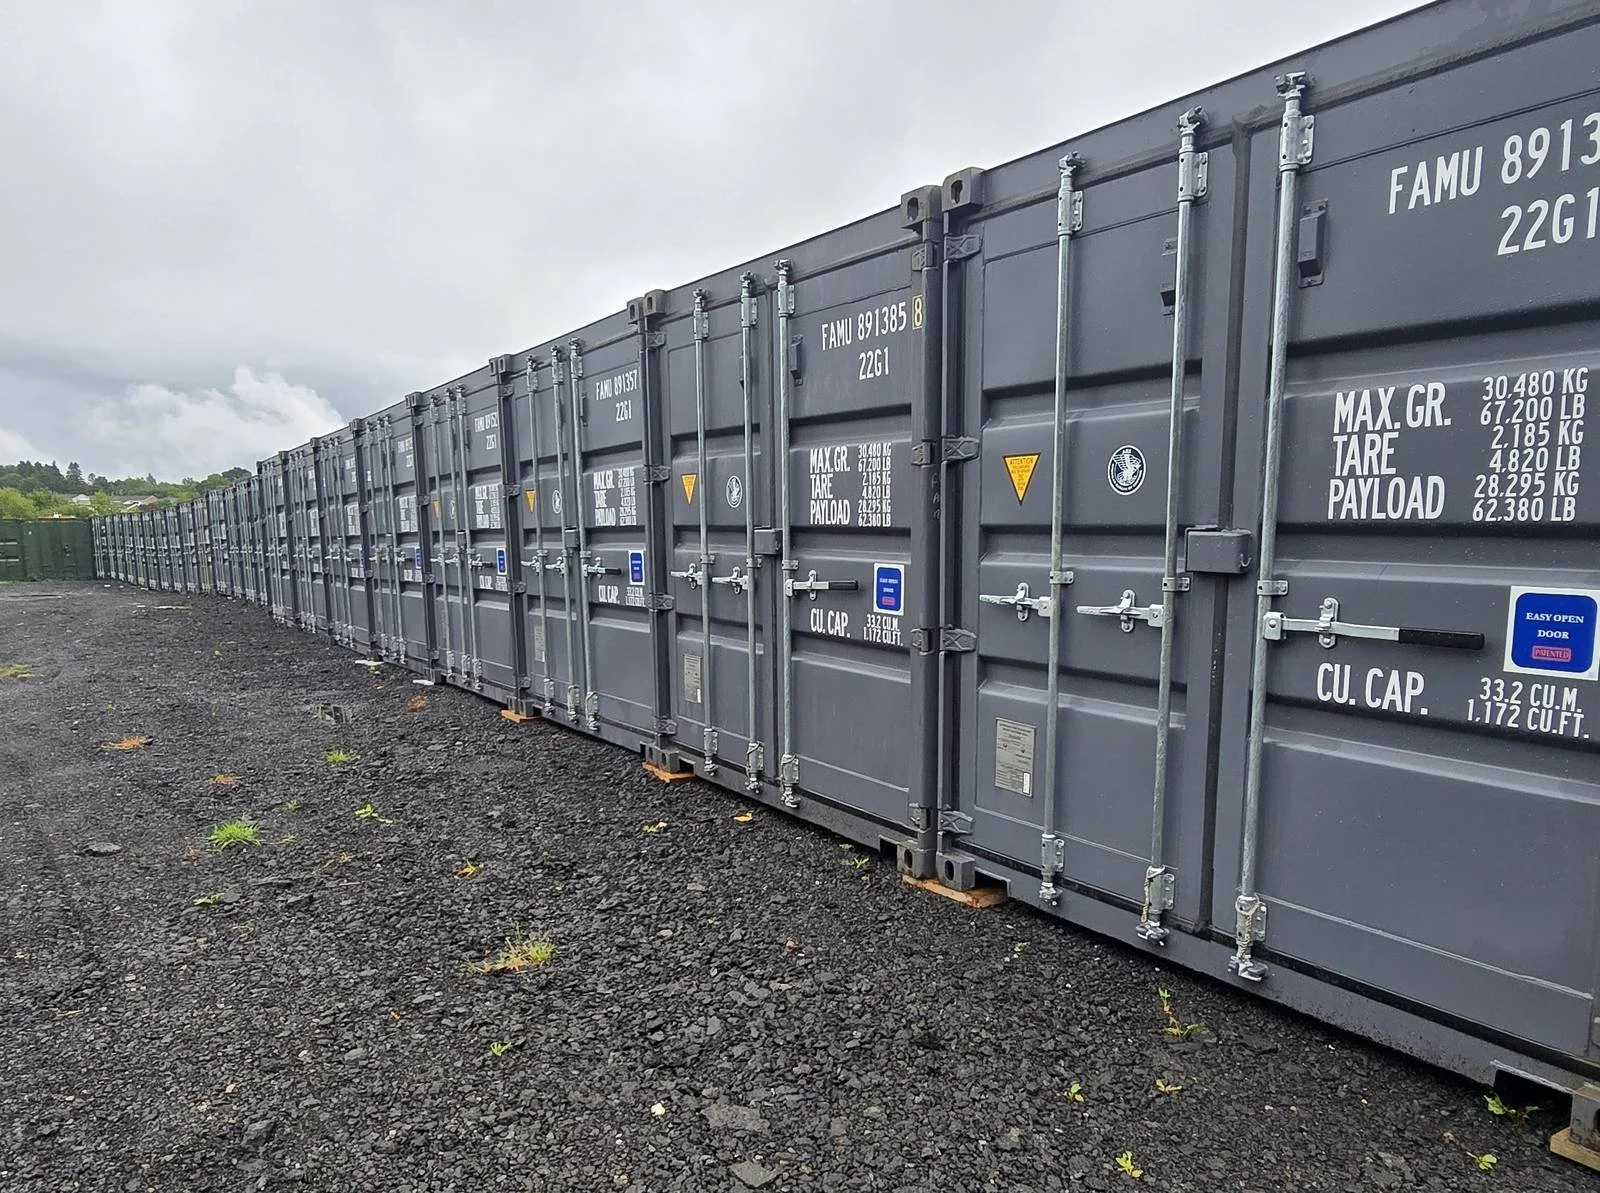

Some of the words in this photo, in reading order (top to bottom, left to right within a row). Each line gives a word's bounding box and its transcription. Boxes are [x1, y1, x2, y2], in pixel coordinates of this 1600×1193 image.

[1388, 146, 1483, 215] FAMU
[1501, 112, 1600, 184] 8913
[1497, 186, 1600, 256] 22G1
[822, 317, 852, 351] FAMU
[857, 301, 907, 341] 891385
[914, 297, 923, 327] 8
[859, 346, 889, 380] 22G1
[1482, 370, 1555, 401] 30,480
[1562, 367, 1589, 394] KG
[1333, 386, 1401, 434] MAX.
[1406, 382, 1452, 428] GR.
[1480, 396, 1553, 426] 67,200
[1560, 393, 1586, 420] LB
[1491, 422, 1550, 450] 2,185
[1557, 420, 1585, 445] KG
[810, 447, 834, 474] MAX.
[834, 445, 851, 472] GR.
[882, 442, 892, 457] KG
[882, 456, 891, 471] LB
[1333, 431, 1399, 477] TARE
[1489, 447, 1549, 473] 4,820
[1555, 446, 1581, 471] LB
[810, 473, 834, 499] TARE
[882, 471, 891, 485] KG
[882, 485, 891, 499] LB
[1474, 472, 1546, 498] 28,295
[1553, 471, 1580, 497] KG
[882, 499, 892, 513] KG
[1327, 475, 1445, 520] PAYLOAD
[1472, 497, 1544, 522] 62,380
[1550, 497, 1576, 522] LB
[810, 499, 851, 525] PAYLOAD
[882, 513, 891, 527] LB
[810, 608, 826, 634] CU.
[827, 610, 851, 638] CAP.
[1525, 612, 1553, 622] EASY
[1553, 614, 1585, 624] OPEN
[1537, 629, 1570, 640] DOOR
[1534, 647, 1570, 659] PATENTED
[1316, 662, 1356, 705] CU.
[1365, 667, 1429, 715] CAP.
[1479, 677, 1524, 705] 33.2
[1467, 698, 1521, 728] 1,172
